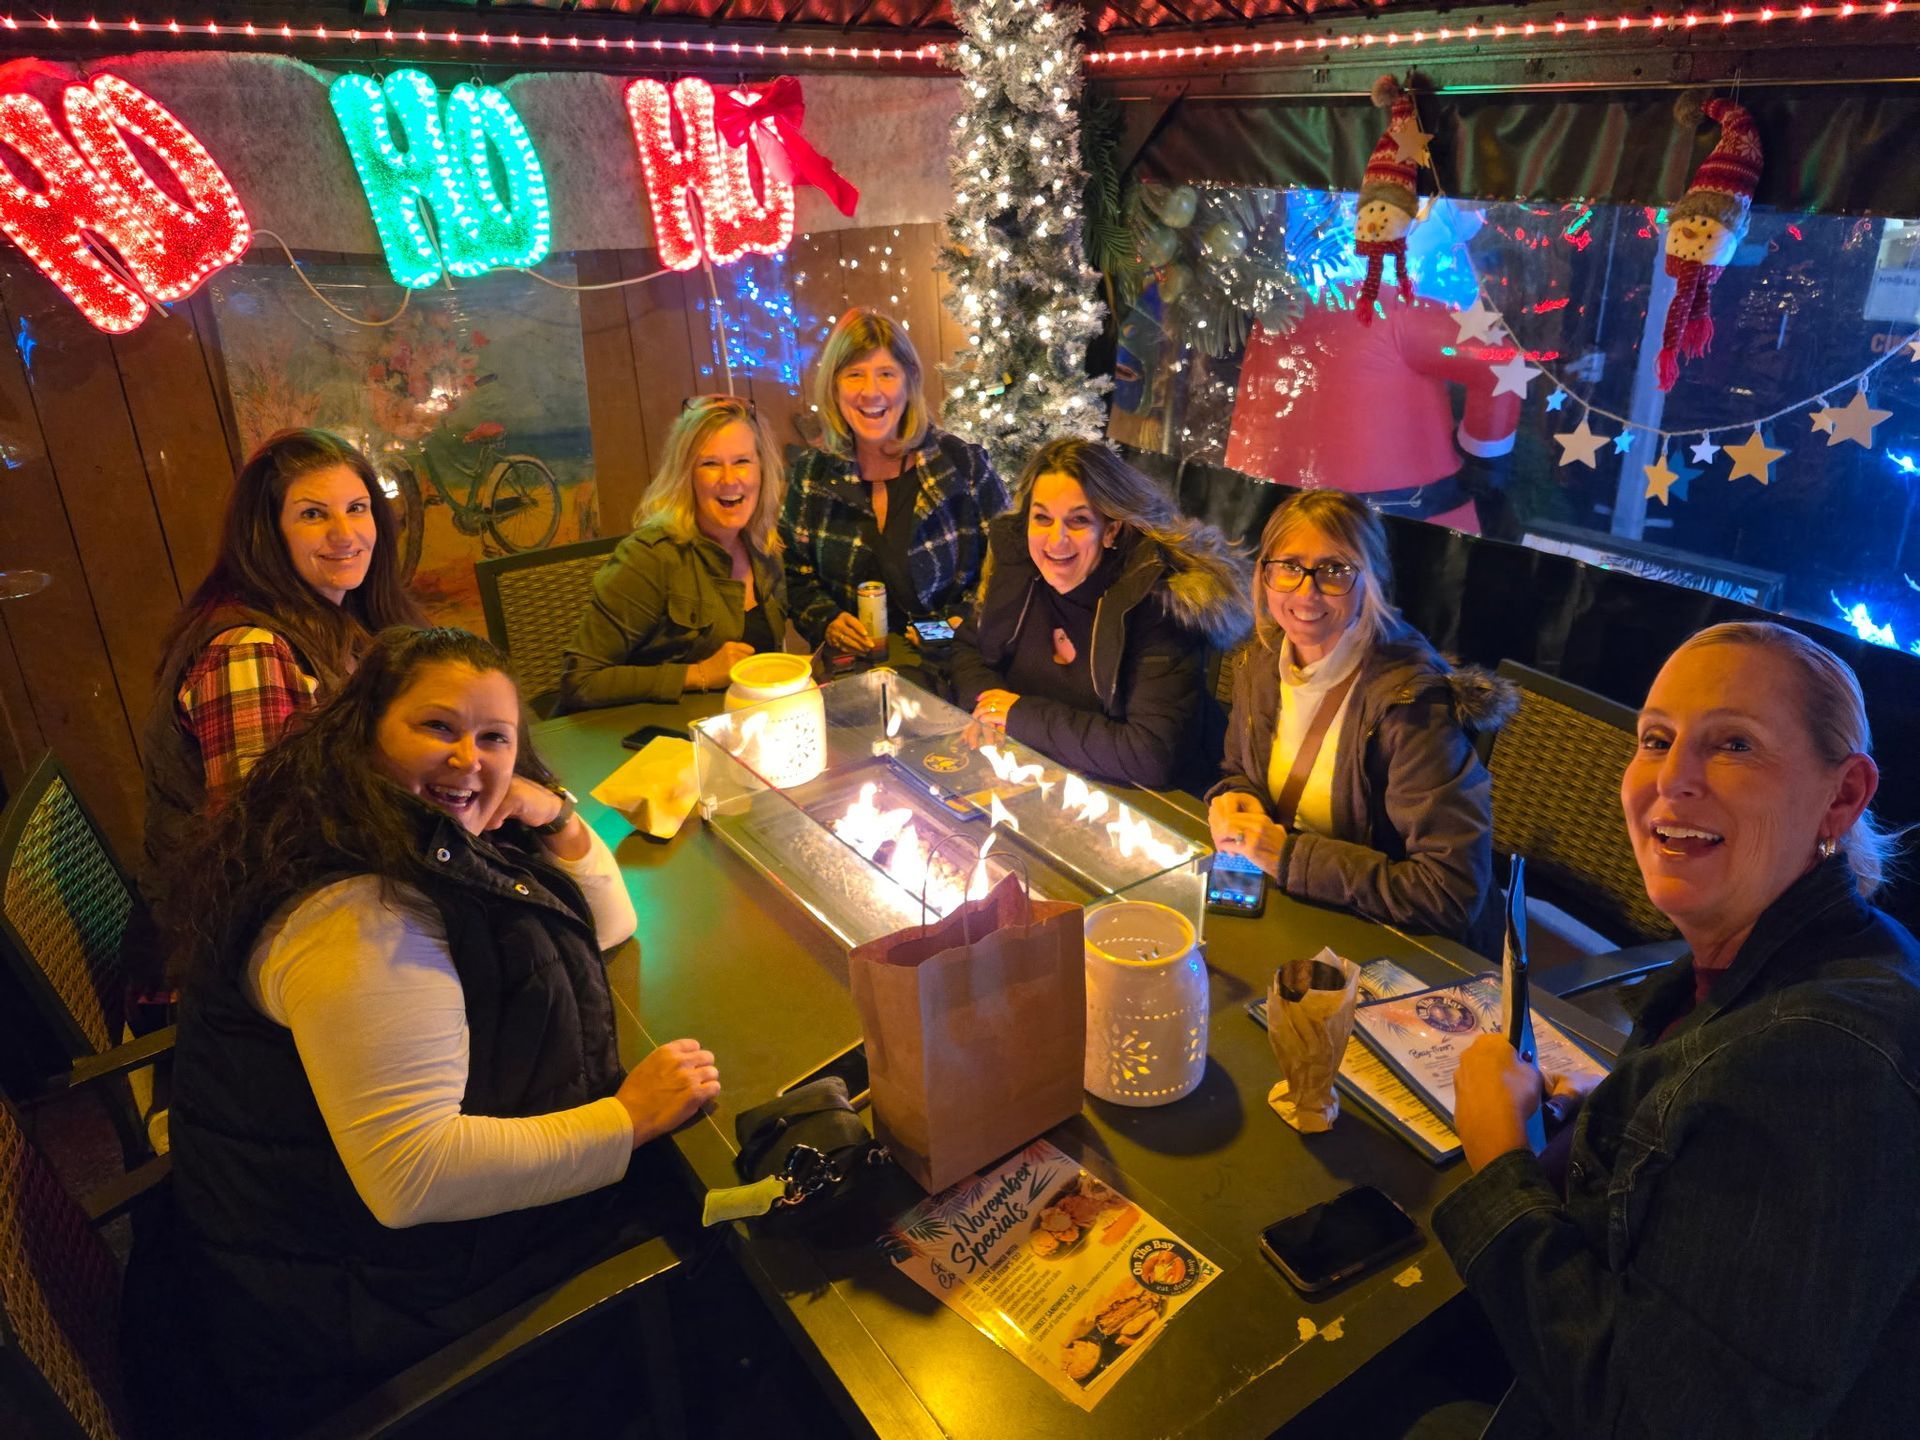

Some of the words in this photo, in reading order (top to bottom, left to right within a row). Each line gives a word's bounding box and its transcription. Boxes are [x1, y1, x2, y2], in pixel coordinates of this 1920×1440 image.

[0, 73, 250, 334] HO
[328, 69, 549, 289] HO
[624, 77, 795, 271] HO
[952, 1162, 1031, 1246] November
[951, 1202, 1028, 1274] Specials
[1133, 1244, 1152, 1259] The
[1152, 1240, 1175, 1251] Bay
[1133, 1262, 1143, 1276] On
